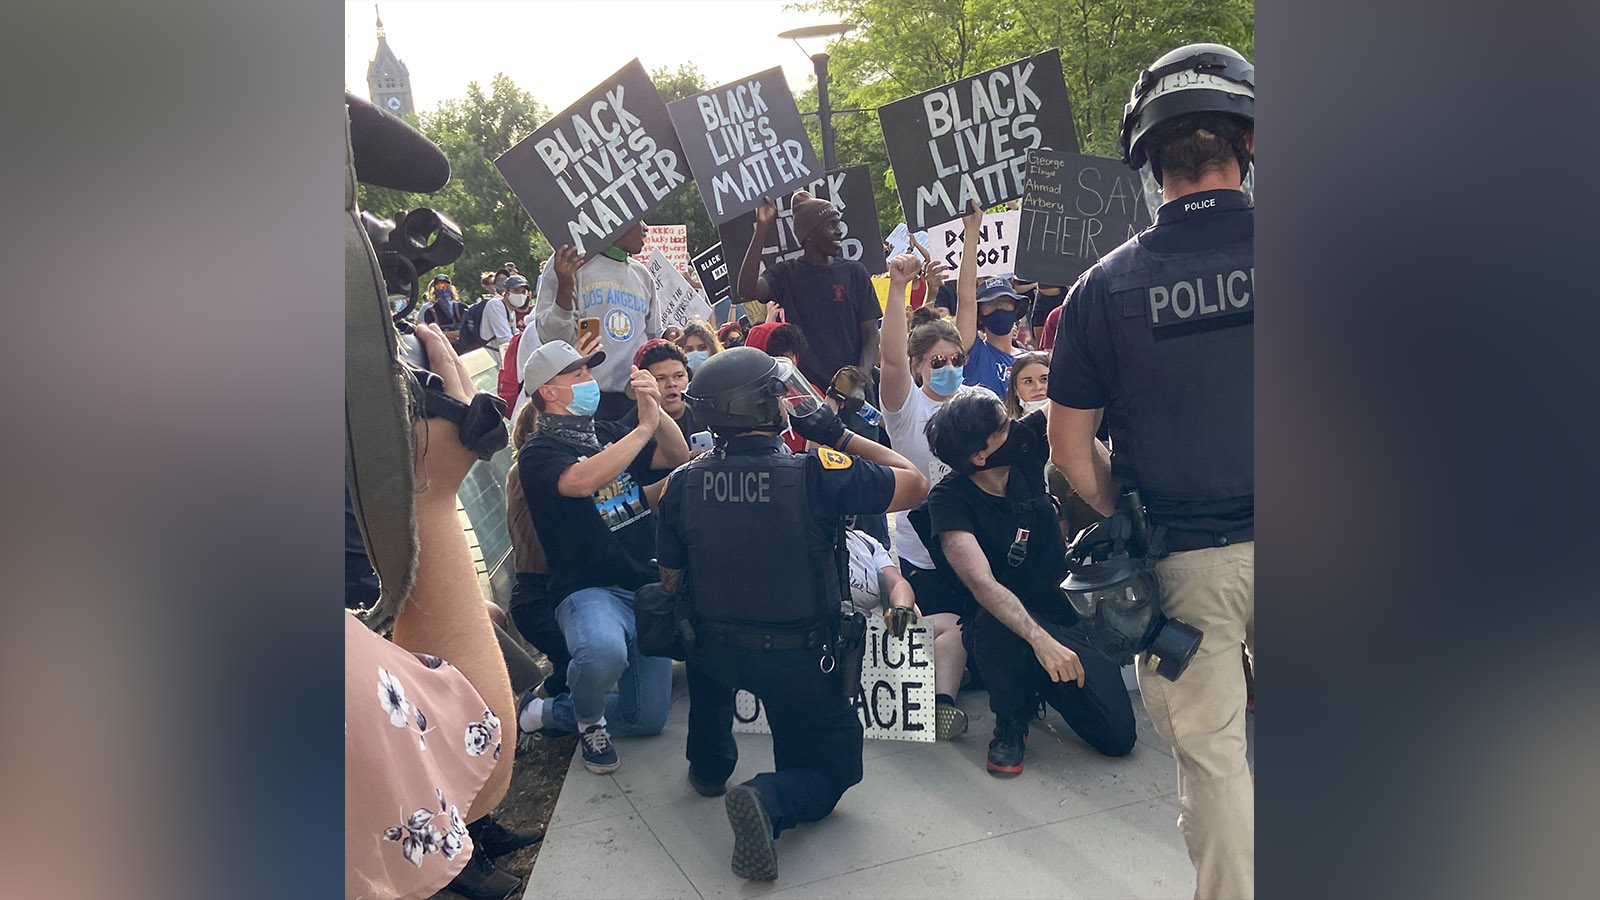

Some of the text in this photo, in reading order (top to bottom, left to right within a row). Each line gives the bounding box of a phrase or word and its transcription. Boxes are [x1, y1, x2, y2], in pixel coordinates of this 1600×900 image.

[697, 80, 769, 132] BLACK
[922, 61, 1042, 138] BLACK
[534, 85, 641, 177] BLACK
[706, 117, 777, 166] LIVES
[928, 113, 1042, 179] LIVES
[555, 127, 657, 208] LIVES
[711, 139, 811, 215] MATTER
[1028, 151, 1065, 169] George
[1030, 165, 1056, 178] Floyd
[567, 148, 686, 254] MATTER
[916, 147, 1053, 227] MATTE
[1024, 193, 1064, 214] Arbery
[1025, 179, 1062, 195] Ahmad
[1076, 166, 1144, 222] SAY
[1184, 199, 1216, 212] POLICE
[945, 245, 1009, 270] SOOT
[1023, 207, 1103, 262] THEIR
[700, 254, 721, 271] BLACK
[582, 289, 603, 309] LOS
[1149, 268, 1254, 323] POLIC
[703, 471, 770, 502] POLICE
